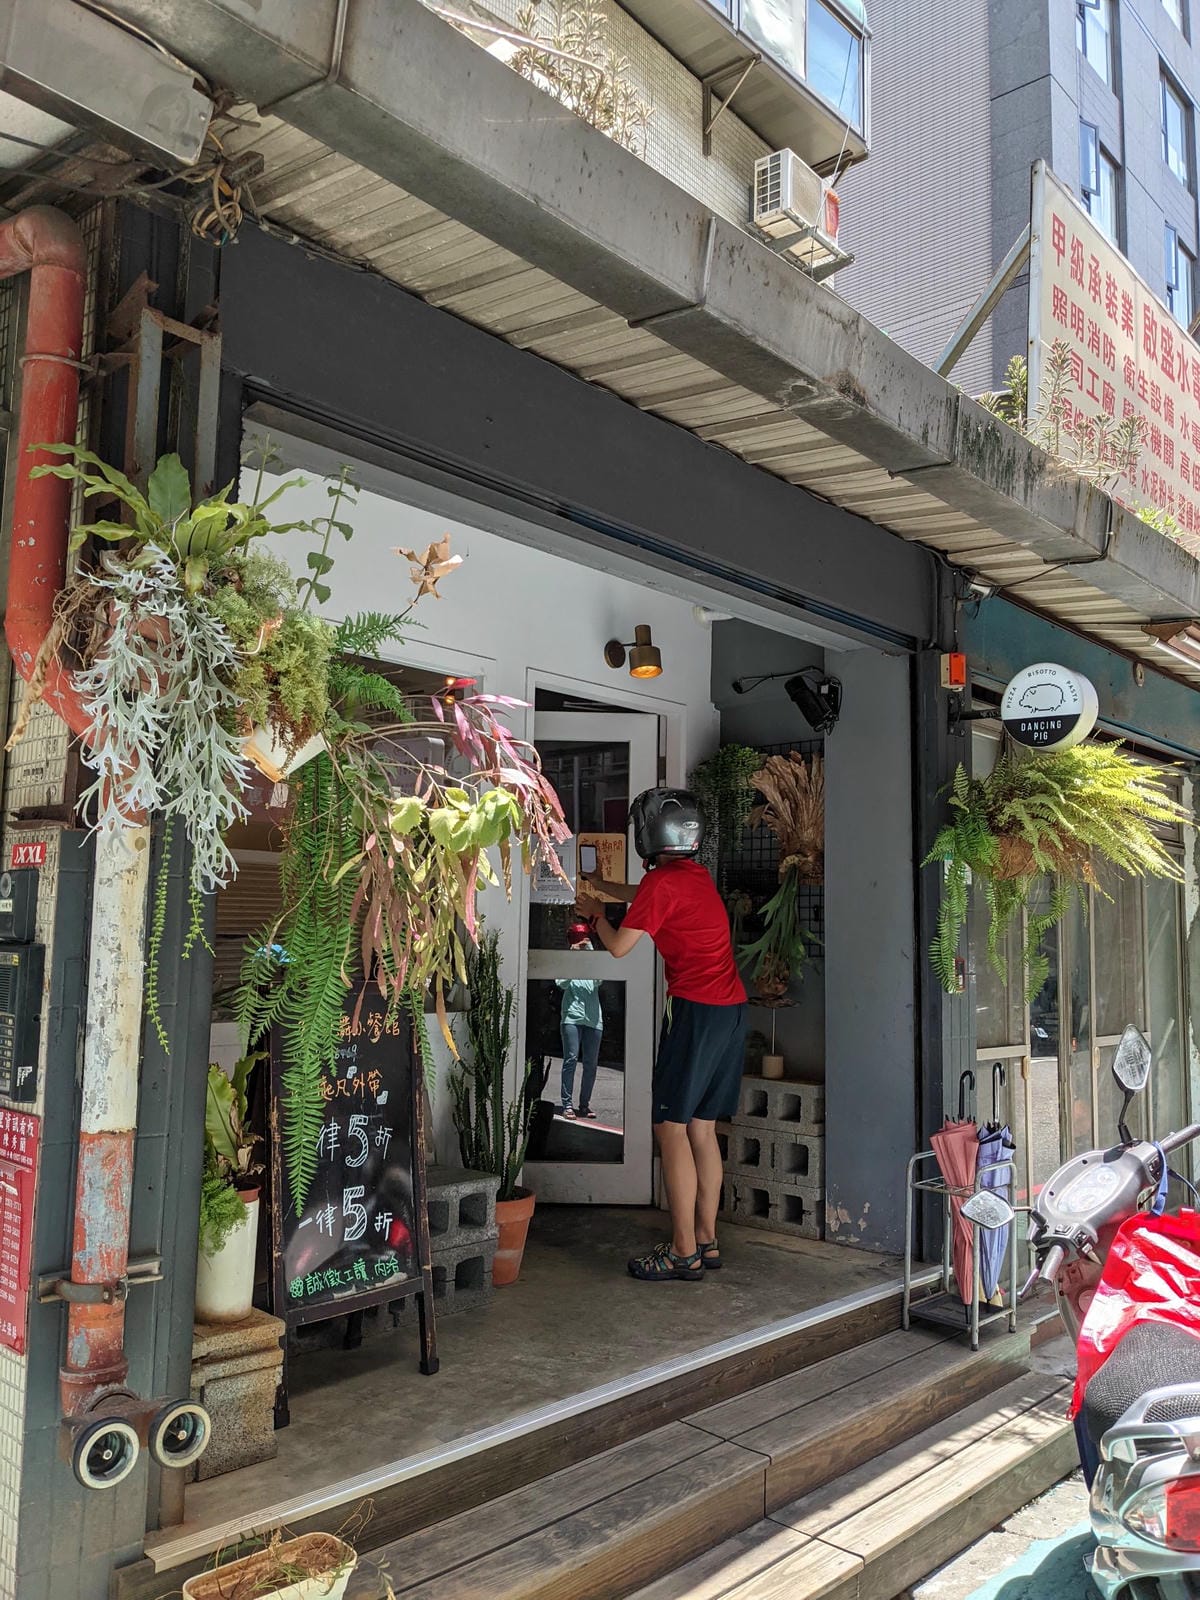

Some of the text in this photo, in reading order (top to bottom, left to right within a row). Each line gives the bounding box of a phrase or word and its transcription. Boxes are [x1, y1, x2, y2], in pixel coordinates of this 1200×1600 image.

[1052, 212, 1134, 341] 甲級承裝業
[1052, 283, 1116, 372] 照明消防
[1123, 353, 1174, 429] 衛生設備
[1006, 668, 1078, 709] PIZZA RISOTTO PASTA
[1021, 720, 1062, 732] DANCING
[1033, 731, 1048, 741] PIG
